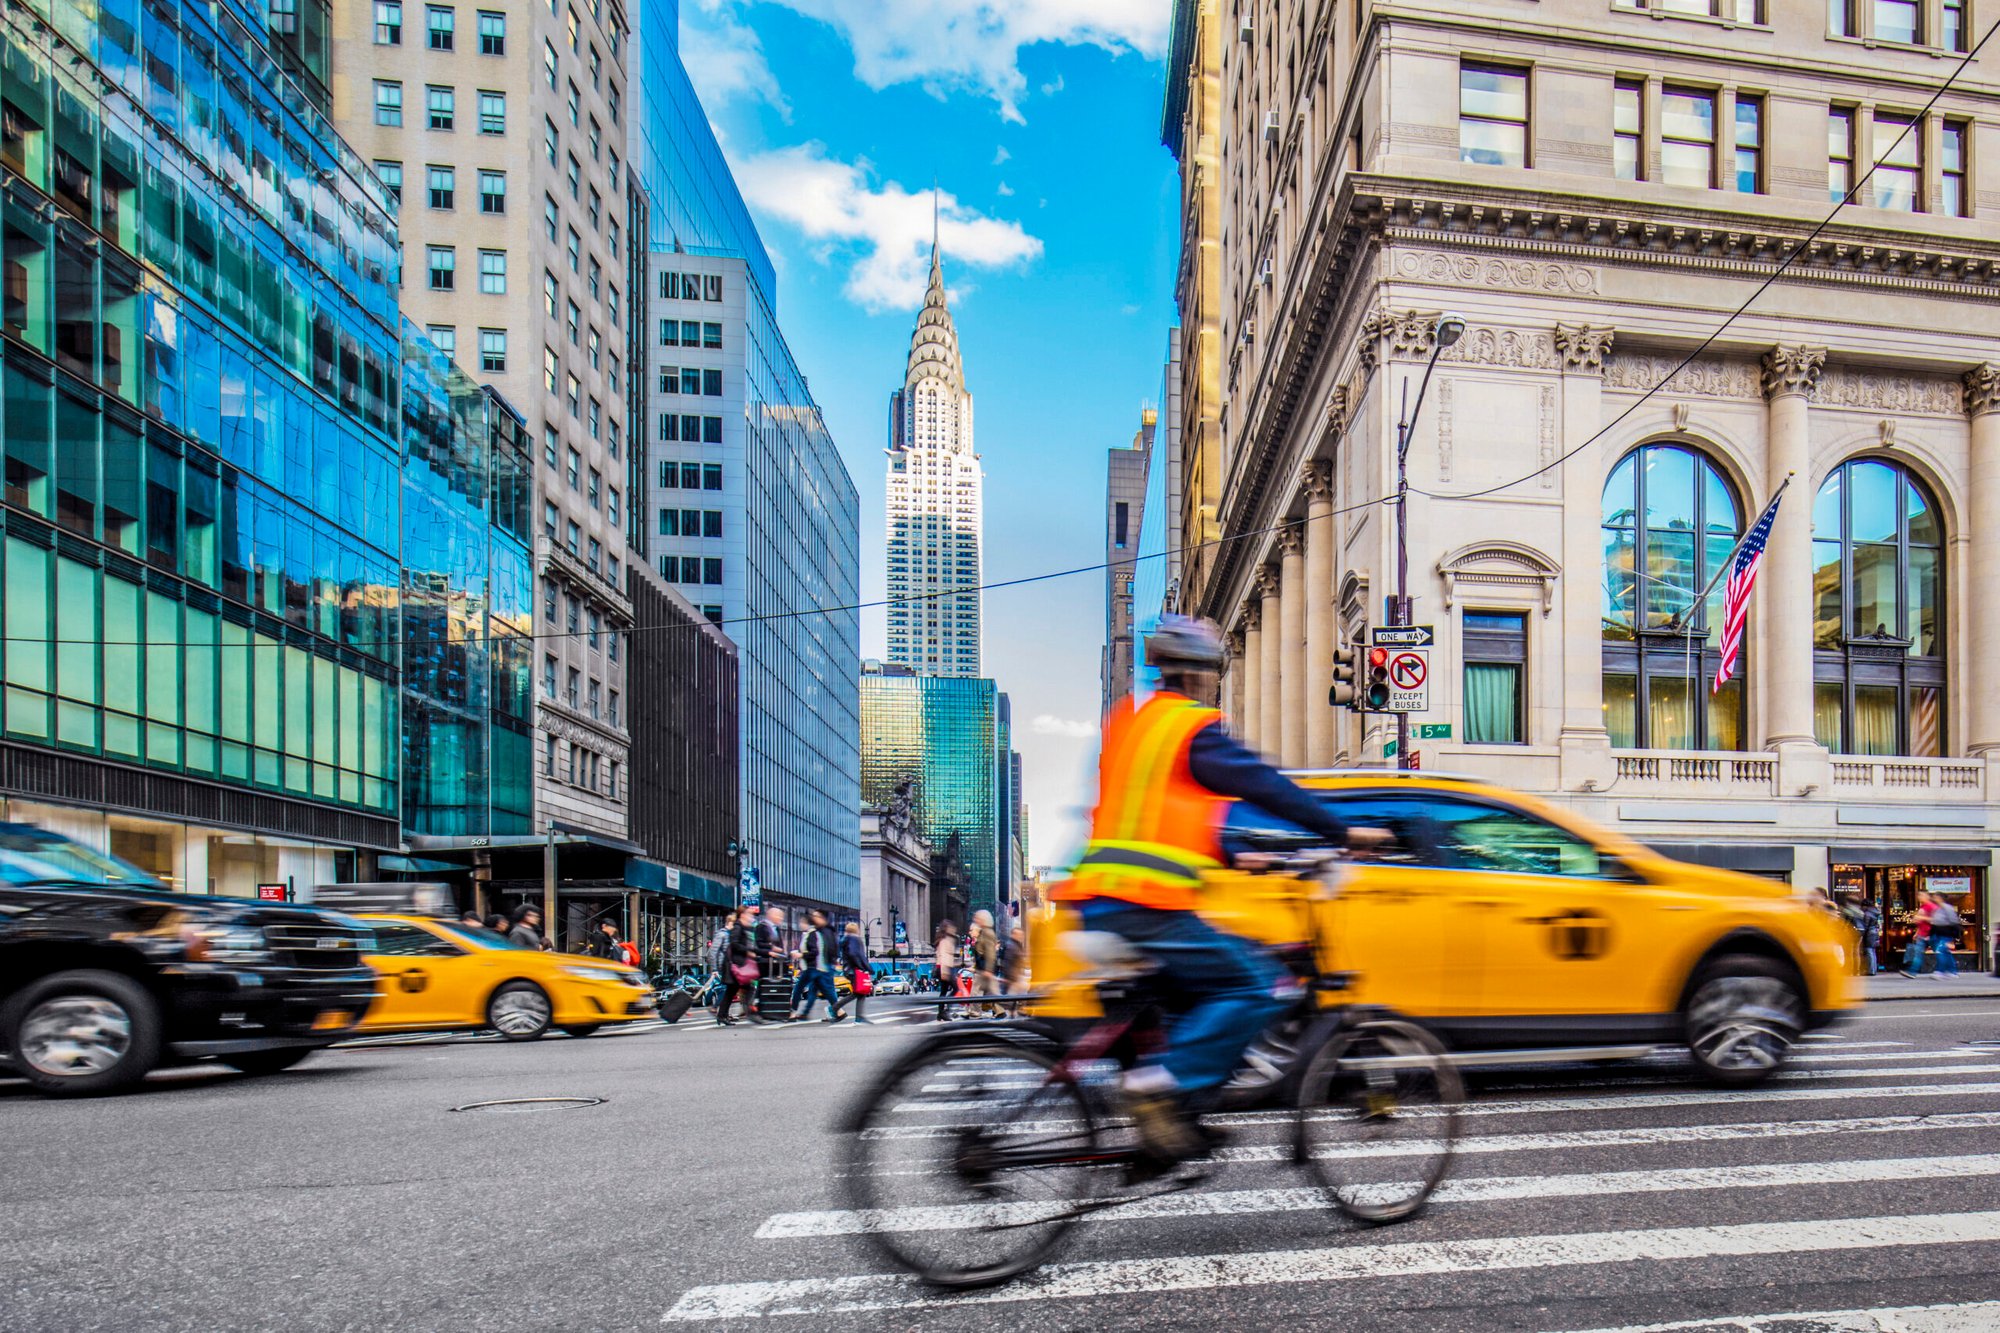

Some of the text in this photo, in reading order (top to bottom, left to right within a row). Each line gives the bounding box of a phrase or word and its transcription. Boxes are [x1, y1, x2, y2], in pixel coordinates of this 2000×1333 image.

[1381, 632, 1425, 641] ONE WAY
[1393, 692, 1423, 700] EXCEPT
[1425, 726, 1433, 738] 5
